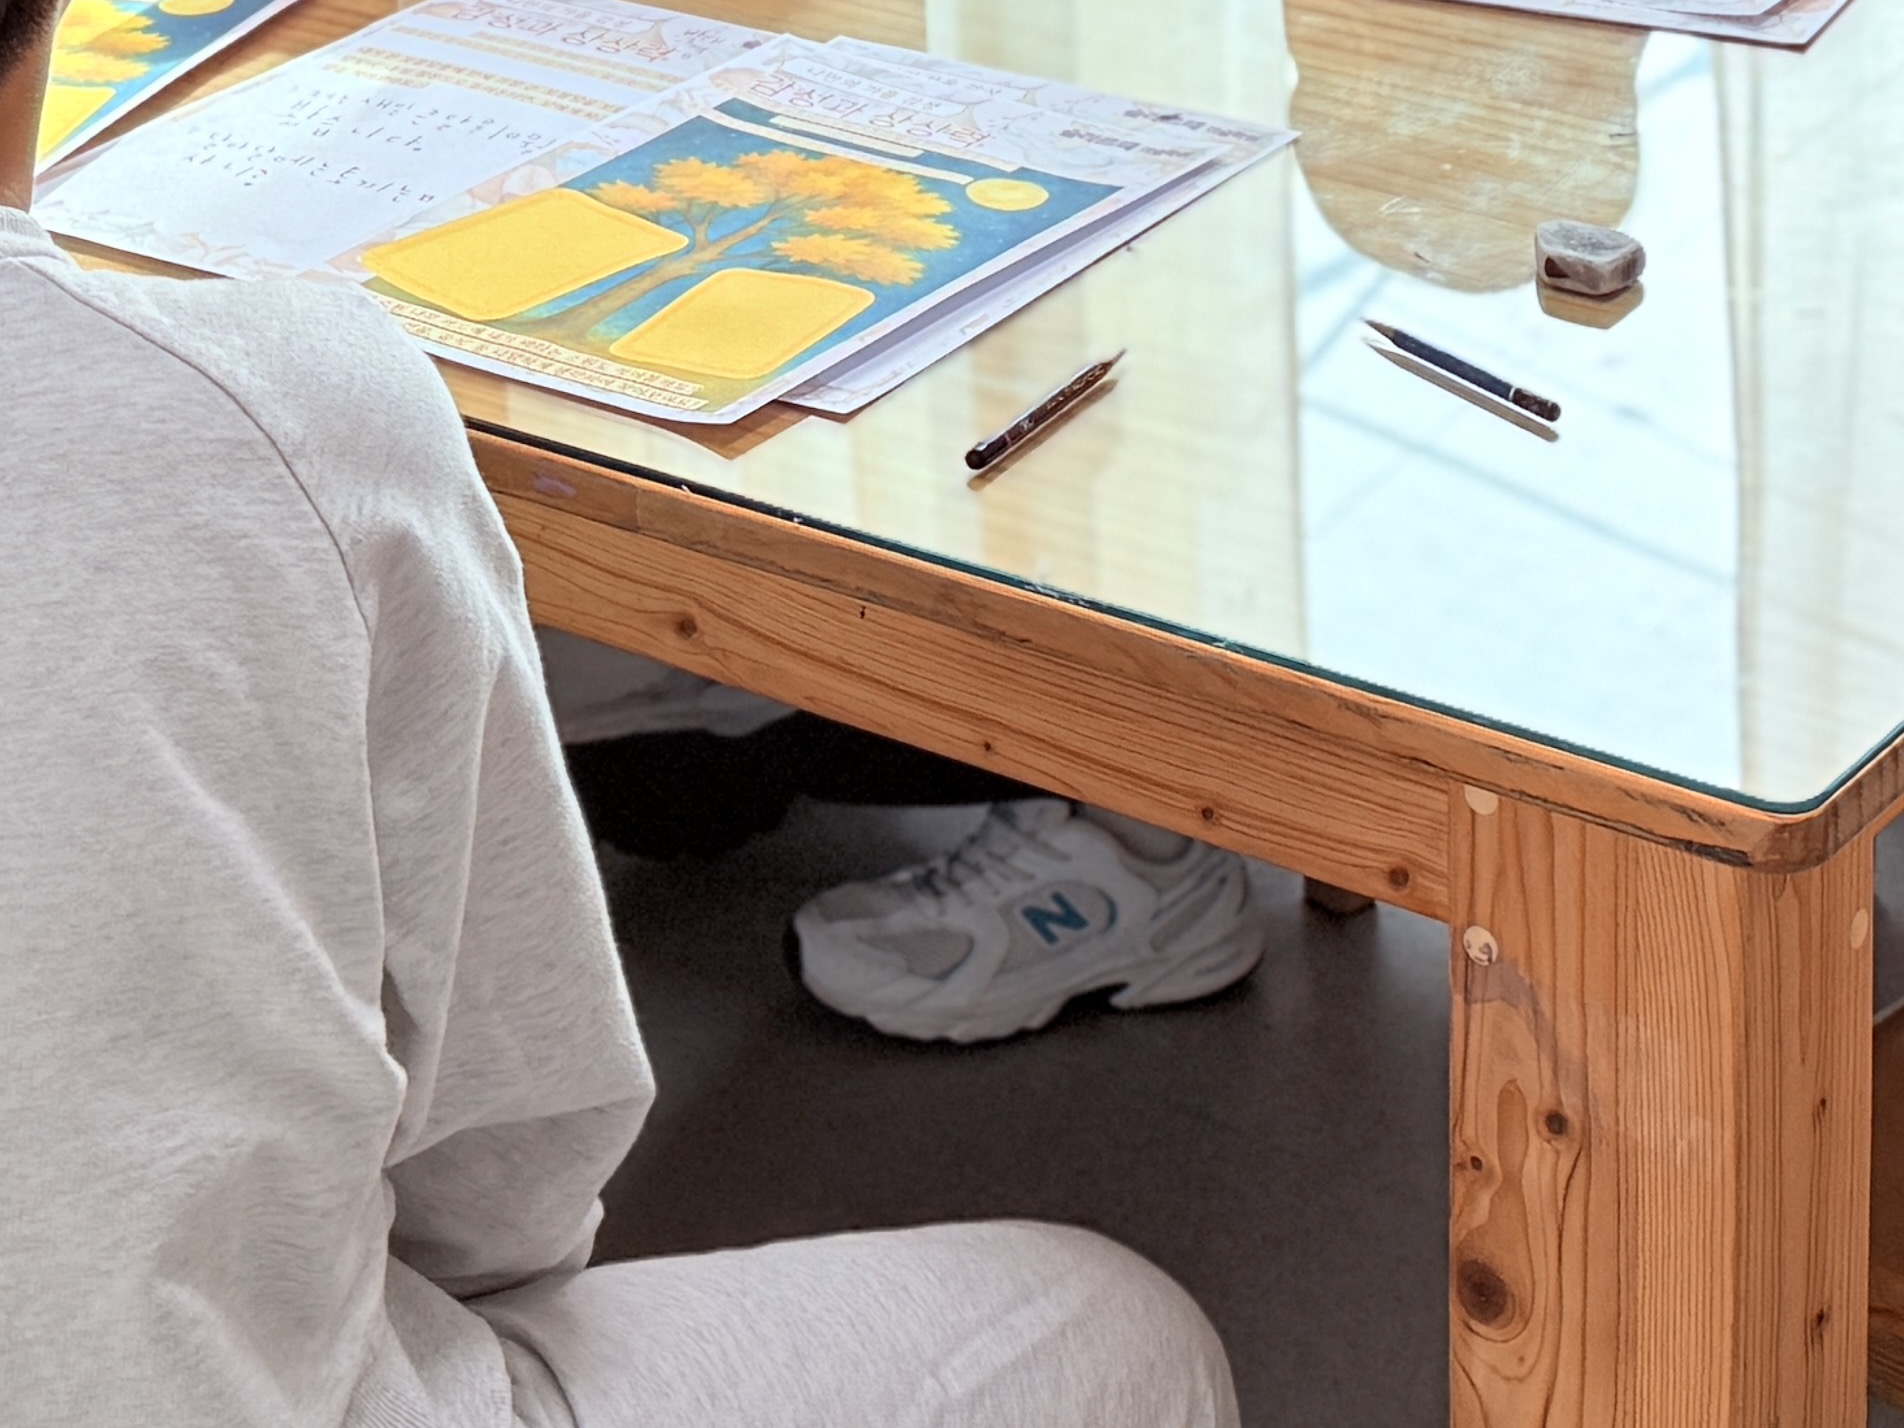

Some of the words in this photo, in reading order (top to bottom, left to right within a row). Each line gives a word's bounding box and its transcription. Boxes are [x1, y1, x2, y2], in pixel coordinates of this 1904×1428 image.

[750, 73, 870, 119] 감성과
[868, 107, 992, 149] 상상력
[1022, 891, 1091, 946] N
